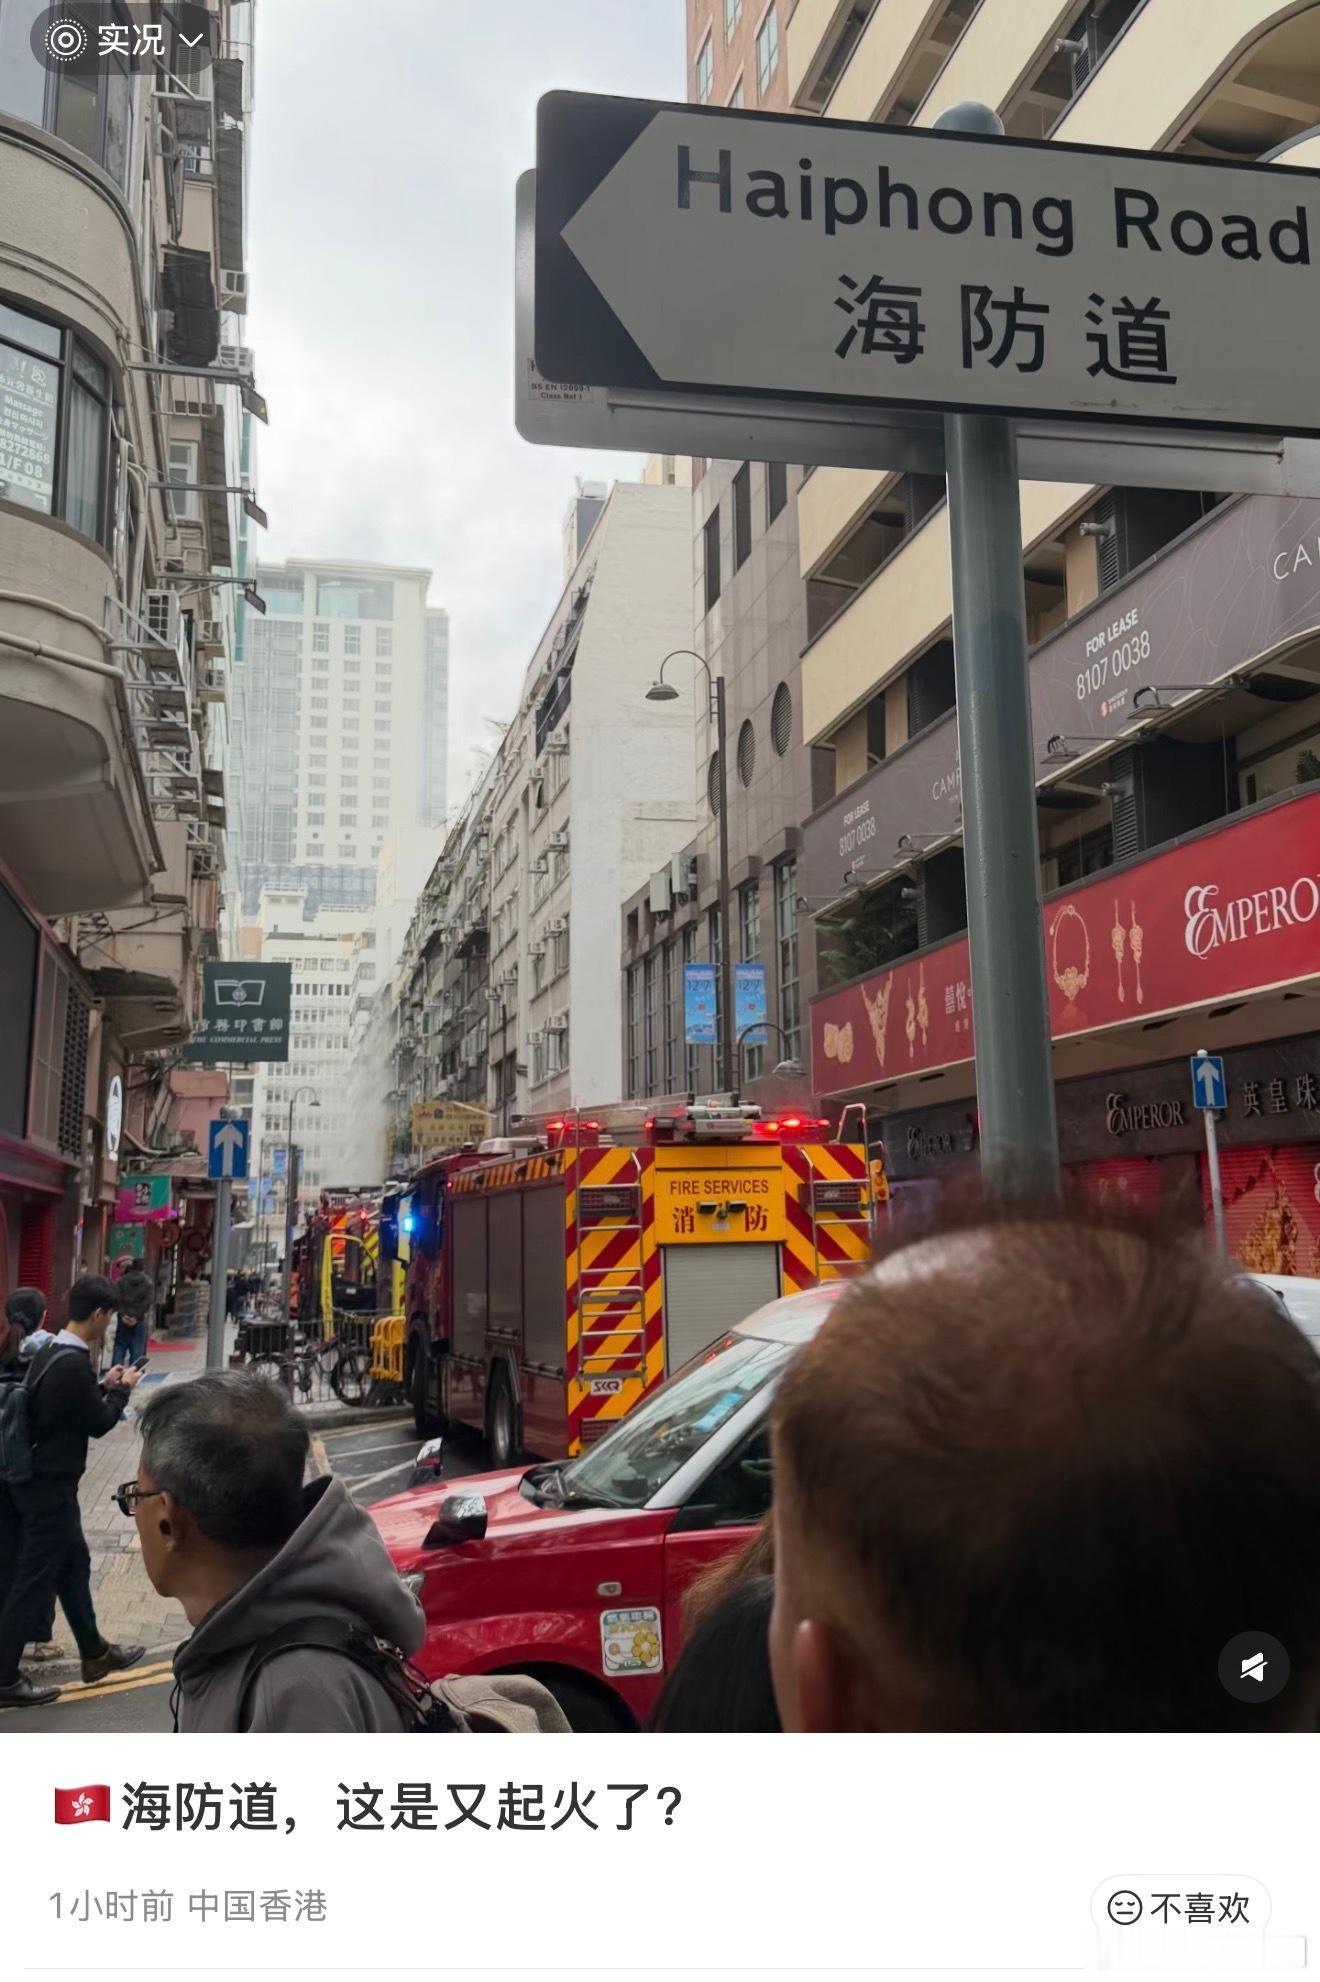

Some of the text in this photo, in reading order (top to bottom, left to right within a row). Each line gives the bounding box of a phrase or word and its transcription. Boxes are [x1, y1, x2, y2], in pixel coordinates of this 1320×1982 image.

[675, 144, 1311, 266] Haiphong Road
[834, 274, 1178, 385] 海防道
[4, 394, 44, 418] Massage
[24, 461, 43, 480] 08
[1273, 535, 1320, 580] CA
[1085, 608, 1139, 658] FOR LEASE
[1076, 656, 1109, 701] 8107
[1112, 630, 1151, 678] 0038
[843, 800, 870, 827] FOR LEASE
[1184, 873, 1320, 961] EMPERO
[1106, 1092, 1185, 1136] EMPEROR
[670, 1179, 769, 1195] FIRE SERVICES
